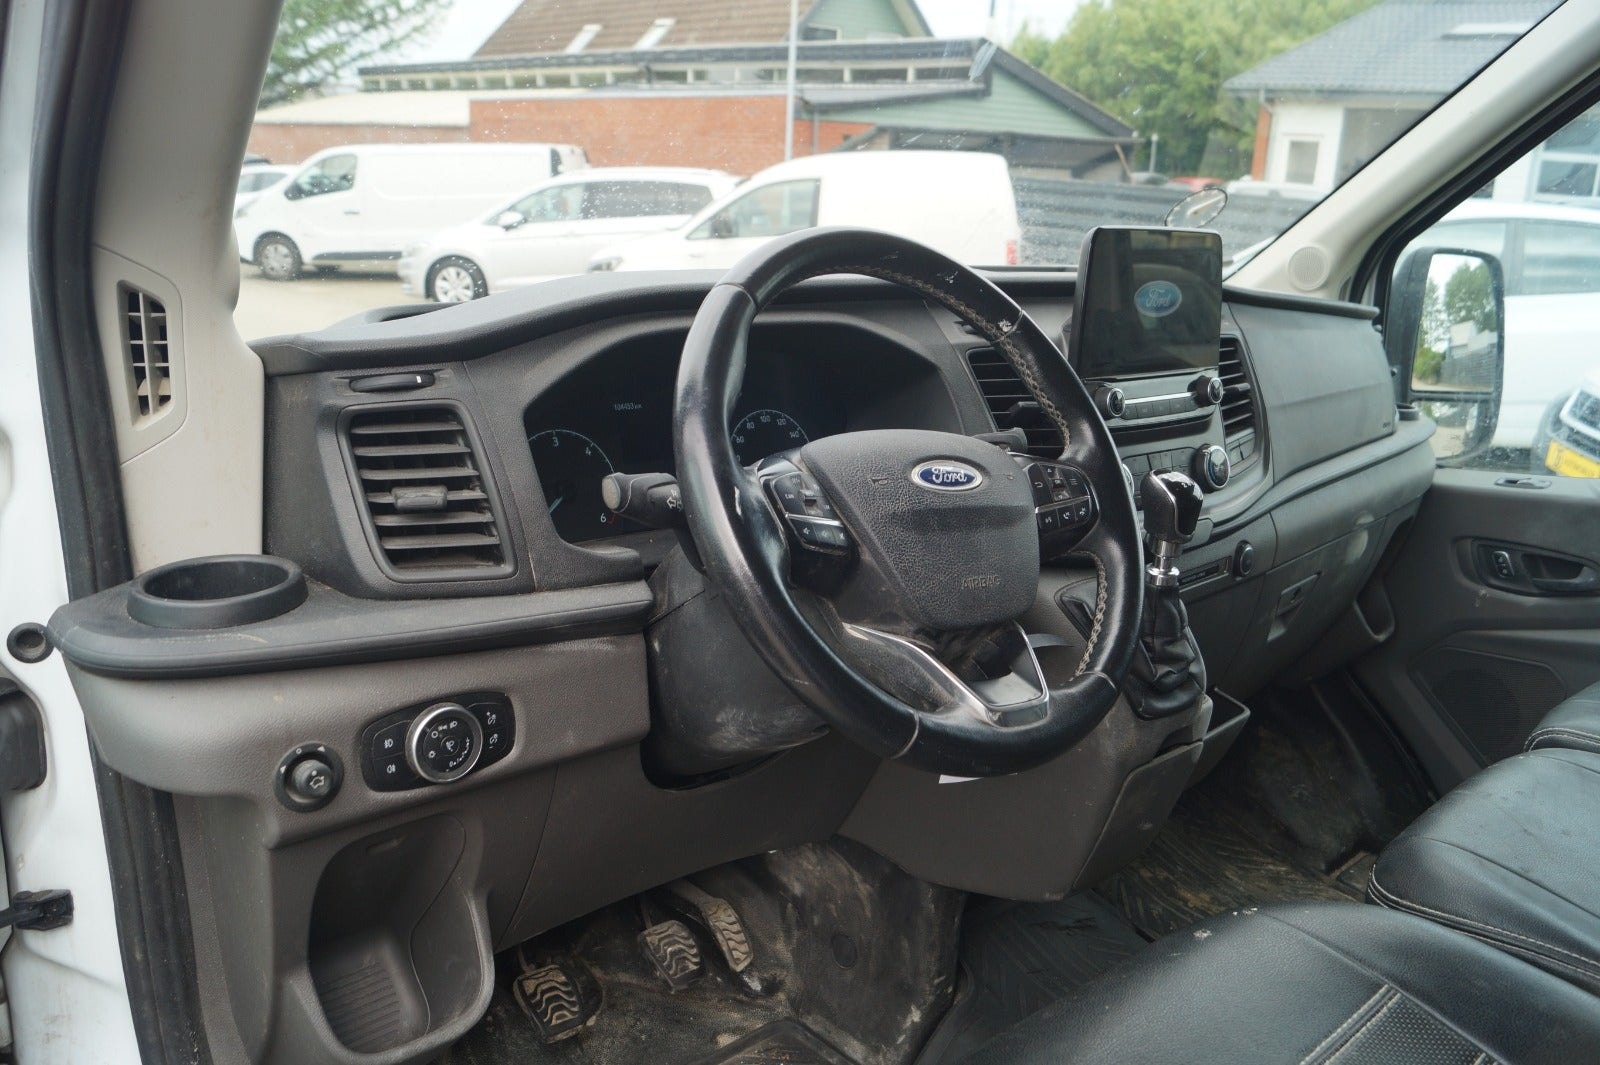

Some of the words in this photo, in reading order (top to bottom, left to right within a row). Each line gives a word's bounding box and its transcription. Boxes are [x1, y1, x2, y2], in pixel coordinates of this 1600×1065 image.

[1146, 288, 1171, 308] Ford
[760, 415, 771, 423] 100
[777, 418, 787, 426] 120
[552, 436, 559, 447] 3
[585, 446, 592, 456] 4
[931, 466, 967, 484] Ford
[600, 512, 607, 523] 6
